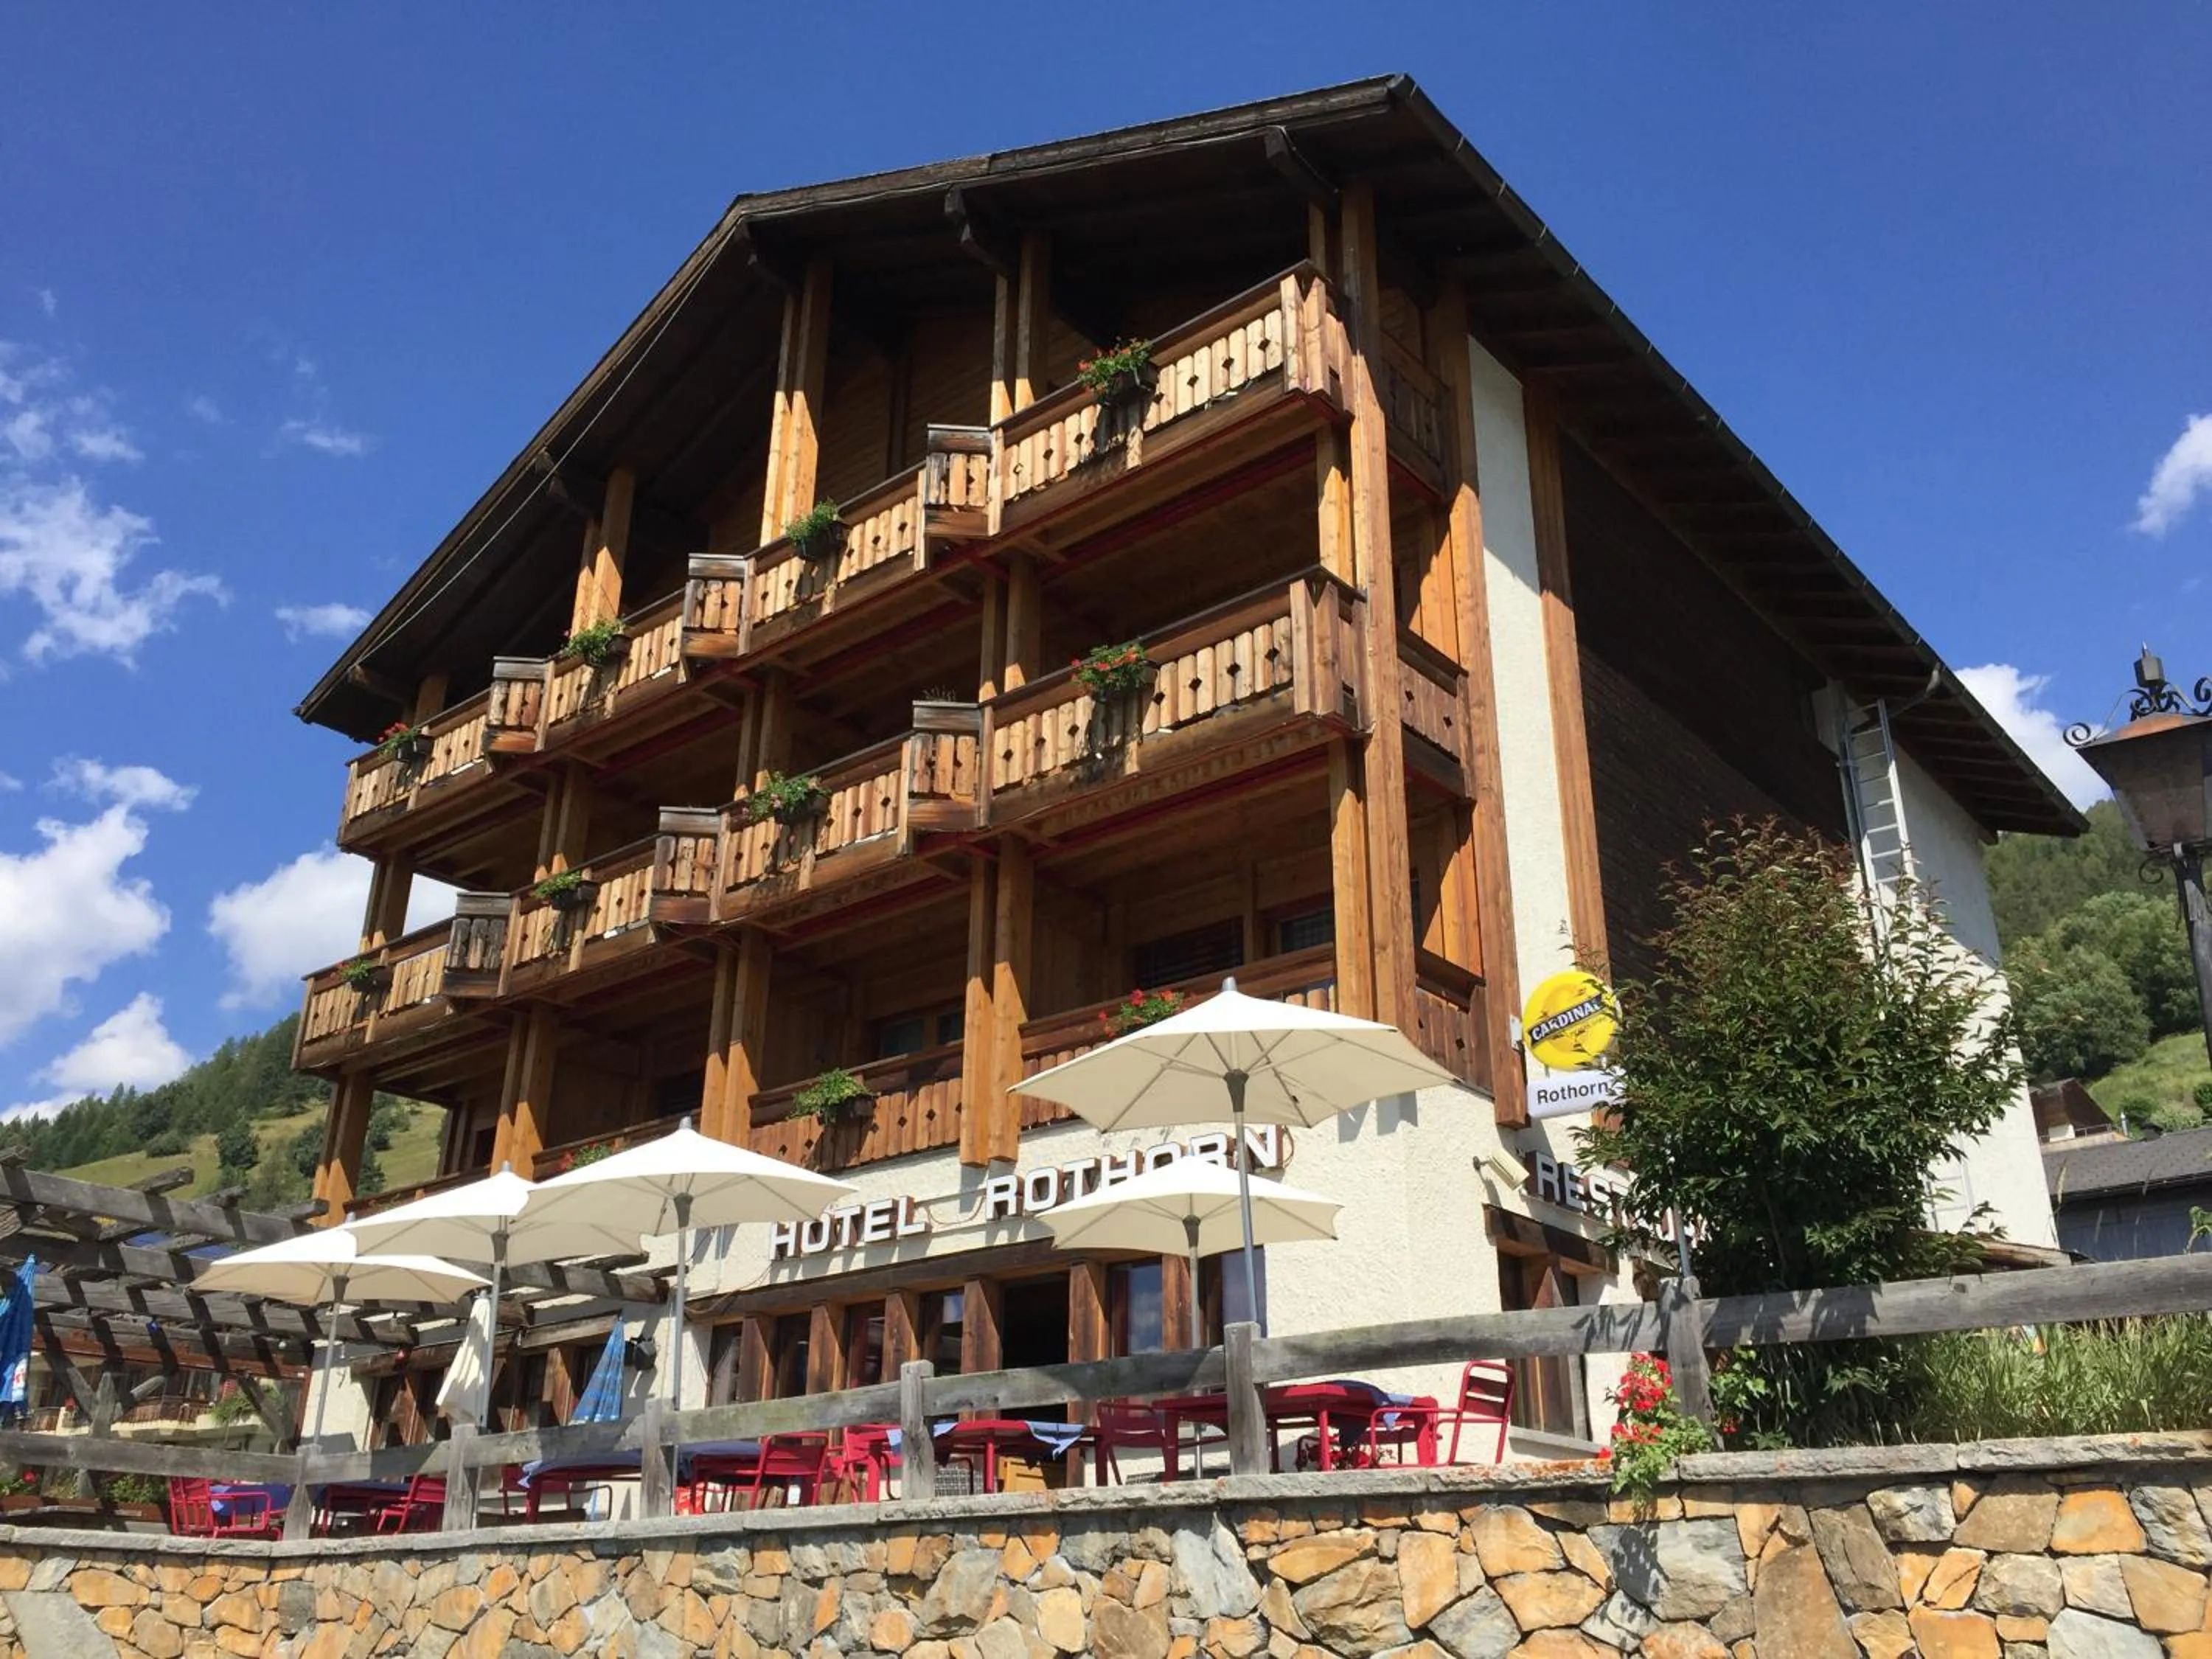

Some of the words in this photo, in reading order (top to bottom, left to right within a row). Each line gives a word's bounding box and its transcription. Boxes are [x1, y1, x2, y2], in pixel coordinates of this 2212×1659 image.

[1531, 999, 1601, 1040] CARDINAL
[1537, 1082, 1608, 1105] Rothorn
[769, 1194, 926, 1260] HOTEL
